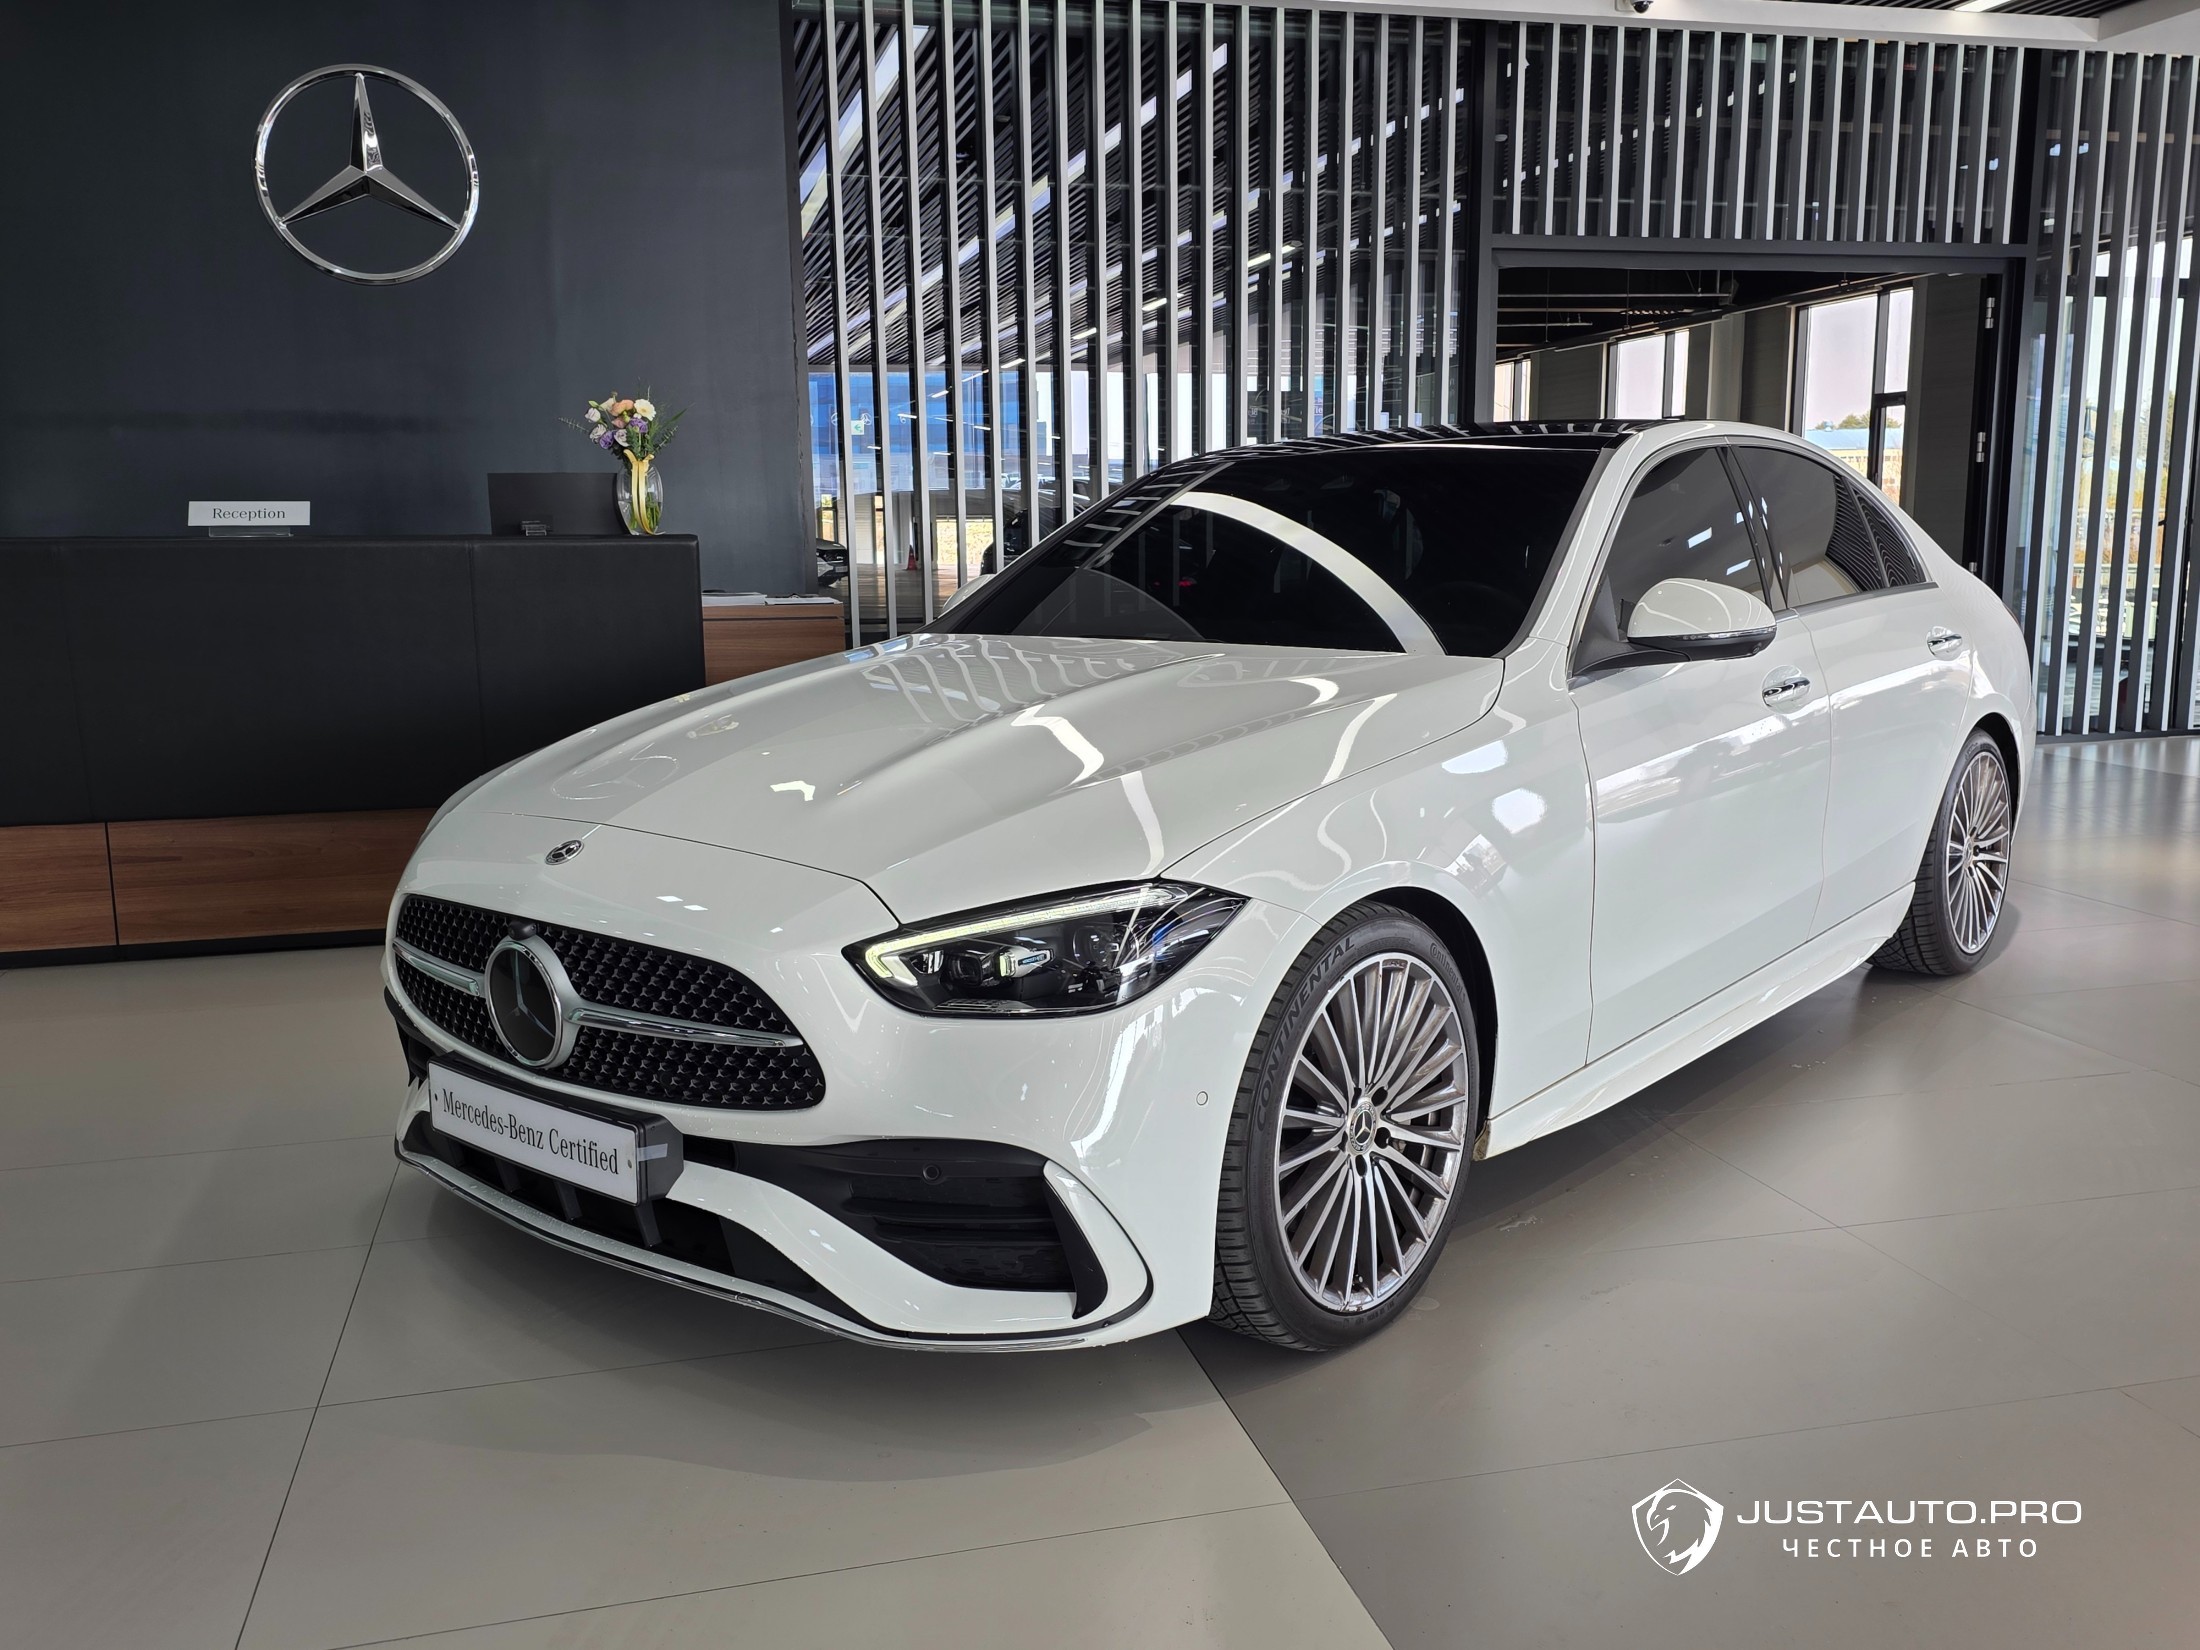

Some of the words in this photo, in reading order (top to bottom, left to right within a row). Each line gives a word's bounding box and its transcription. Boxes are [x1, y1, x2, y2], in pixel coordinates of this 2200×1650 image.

[212, 507, 286, 522] Reception
[1256, 936, 1356, 1132] CONTINENTAL
[442, 1088, 544, 1150] Mercedes-Benz
[549, 1128, 619, 1175] Certified
